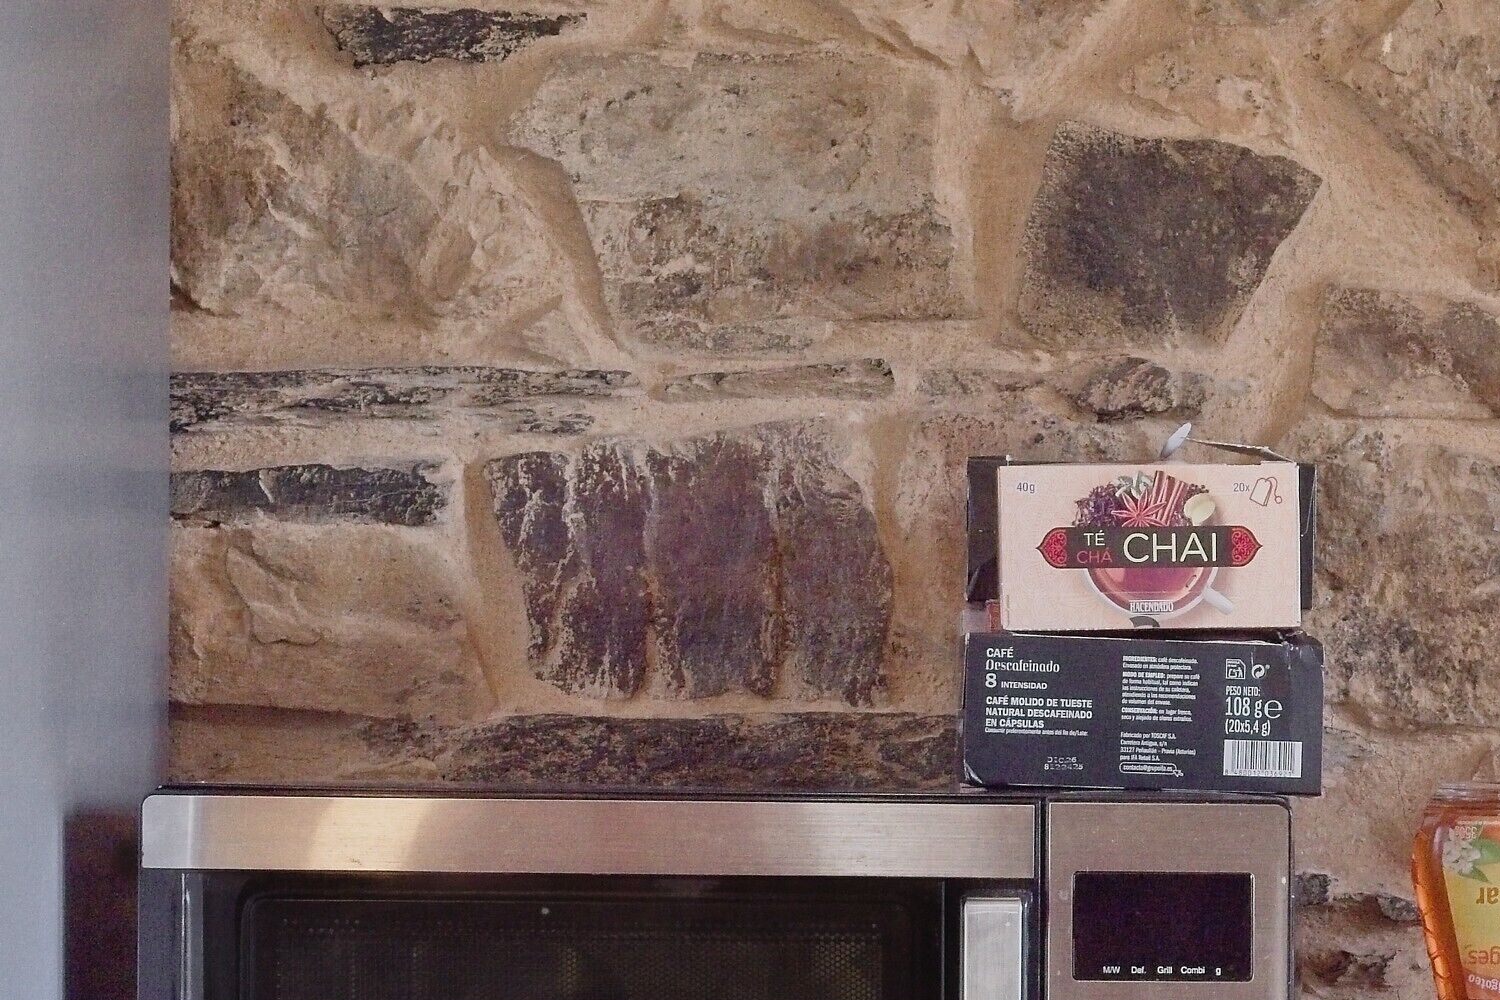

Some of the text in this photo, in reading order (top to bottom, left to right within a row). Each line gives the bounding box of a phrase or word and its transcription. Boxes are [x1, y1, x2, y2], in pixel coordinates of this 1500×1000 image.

[1017, 482, 1035, 493] 40g
[1233, 483, 1249, 492] 20x
[1084, 530, 1105, 546] TÉ
[1123, 532, 1216, 563] CHAI
[1077, 547, 1113, 564] CHÁ
[1130, 602, 1174, 612] HACENDADO
[986, 647, 1014, 658] CAFÉ
[986, 659, 1060, 672] Descafeinado
[985, 673, 1047, 689] 8 INTENSIDAD
[1226, 686, 1260, 696] PESO NETO:
[986, 695, 1092, 708] CAFÉ MOLIDO DE TUESTE
[1226, 697, 1250, 716] 108
[1254, 700, 1262, 718] g
[986, 708, 1092, 718] NATURAL DESCAFEINADO
[1000, 718, 1044, 728] CÁPSULAS
[1225, 719, 1270, 736] (20x5,4 g)
[1103, 966, 1221, 975] M/W Def. Grill Combi g
